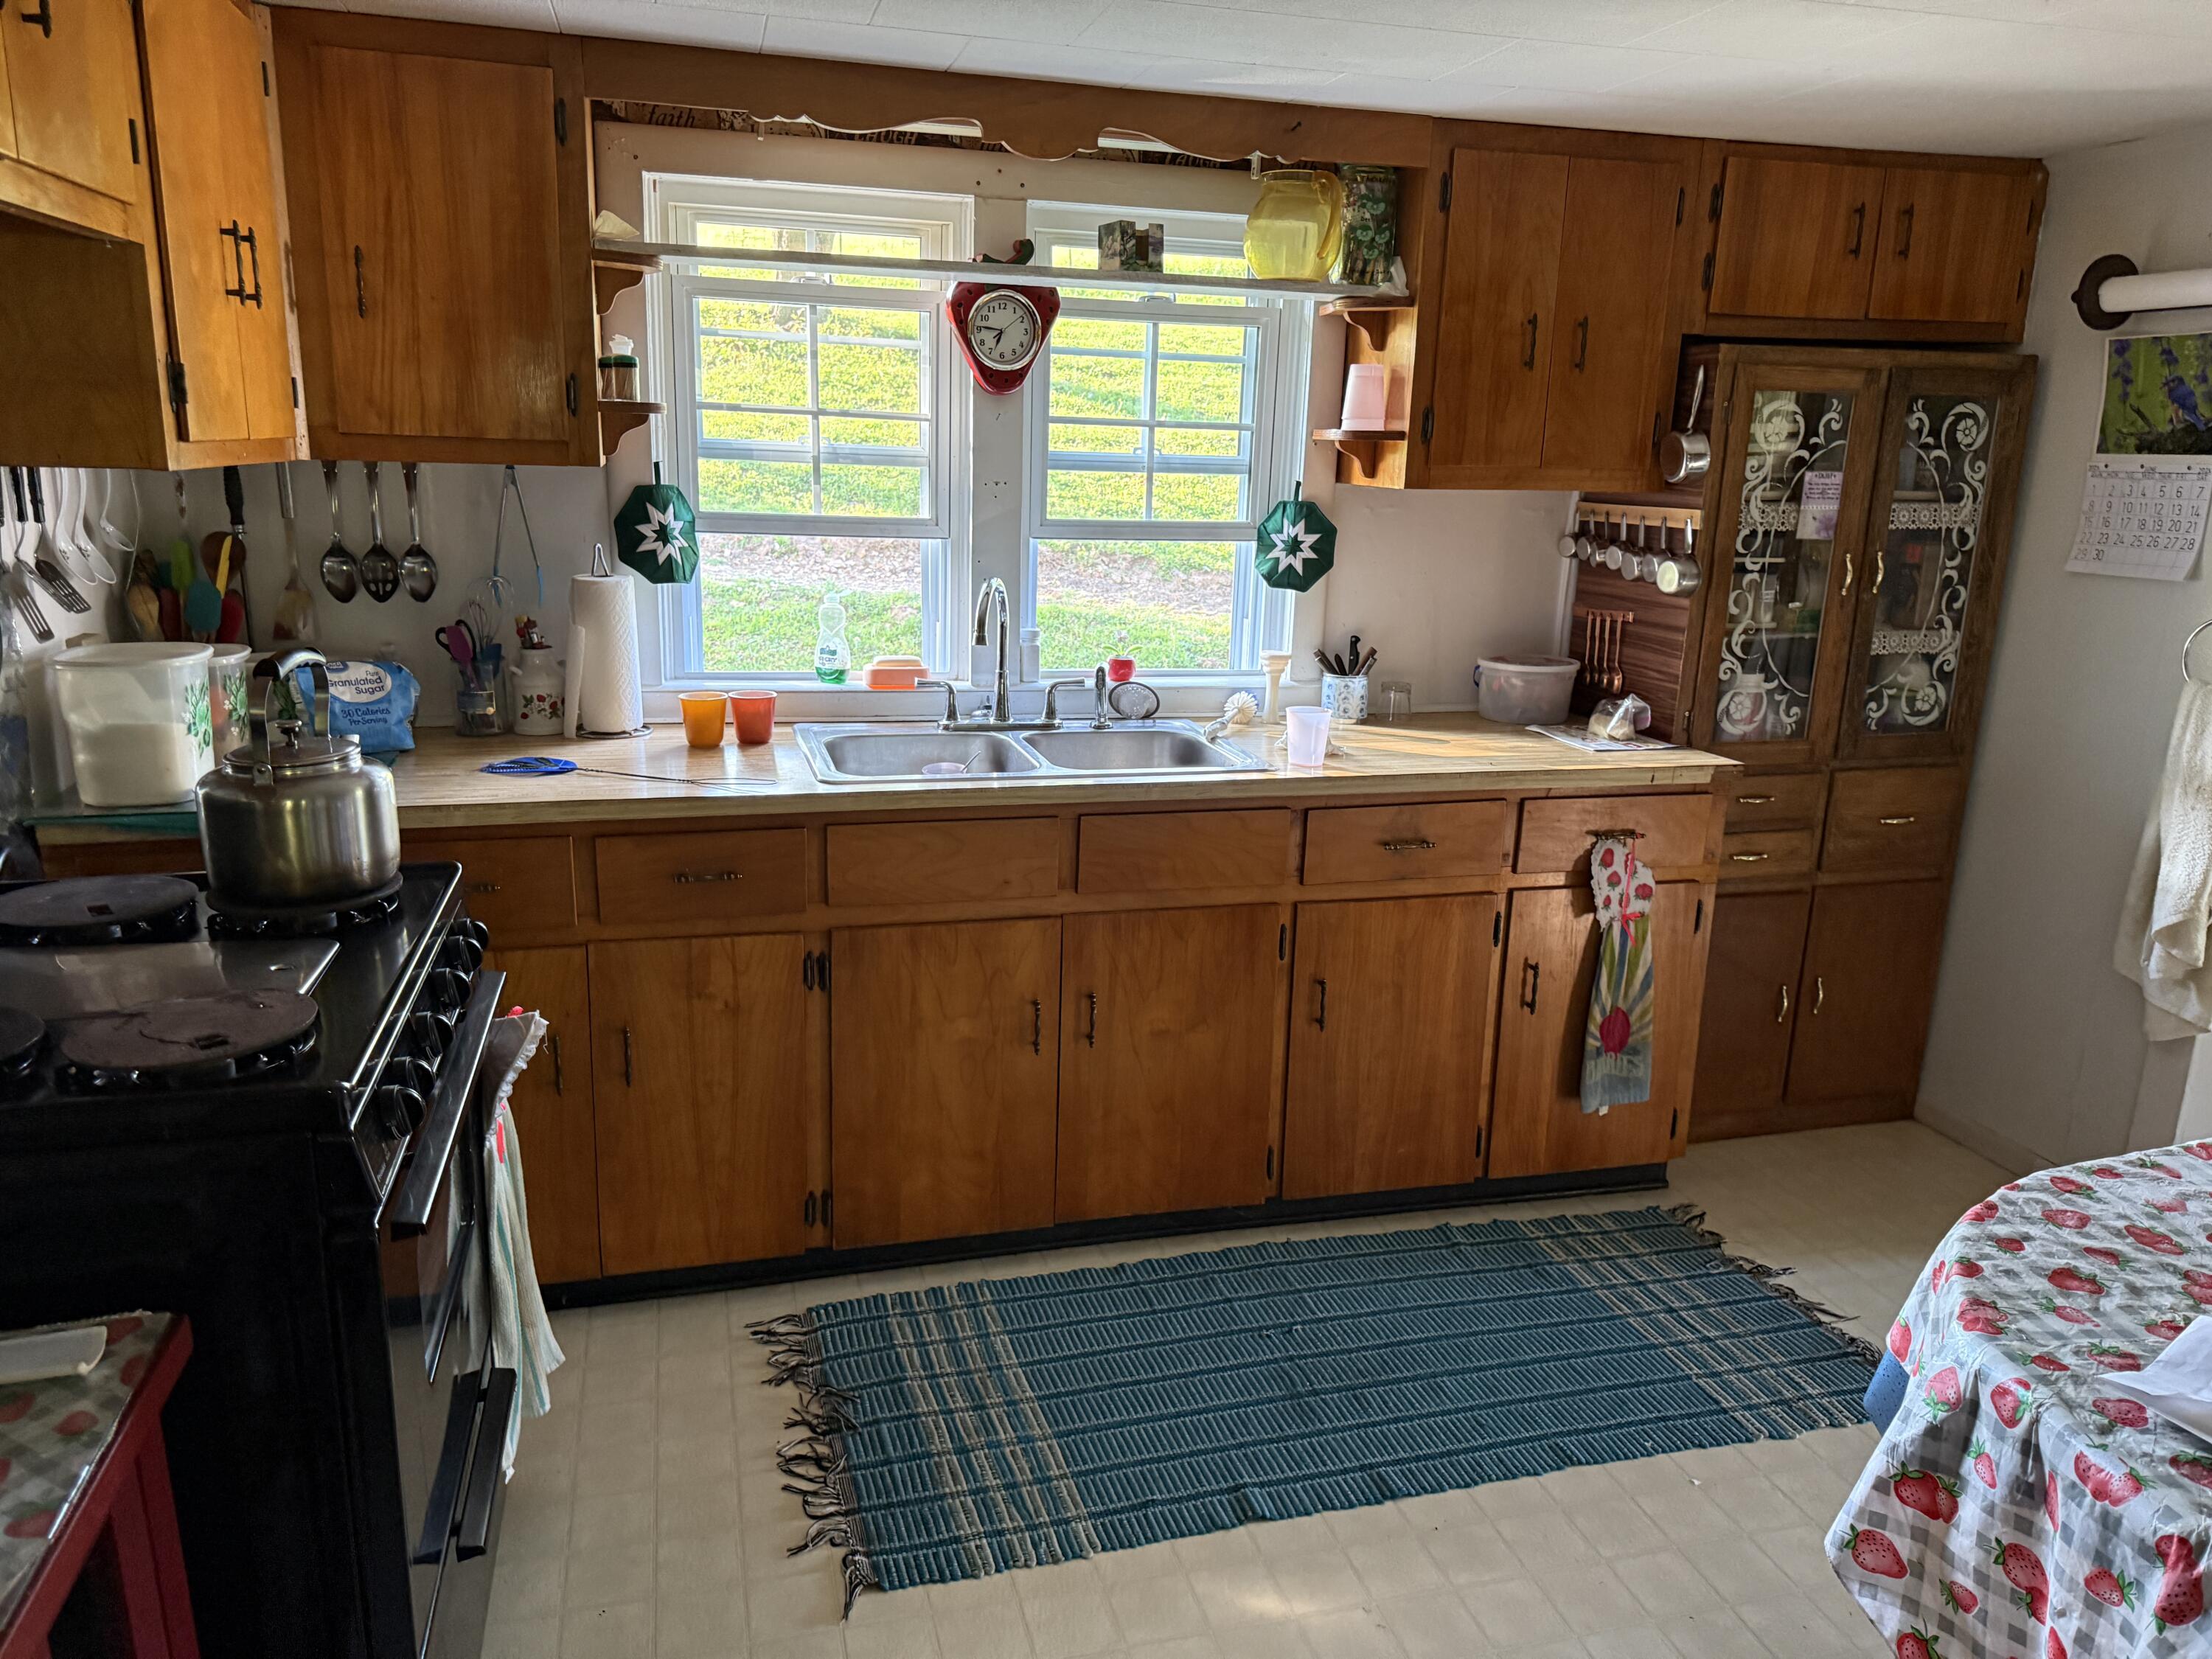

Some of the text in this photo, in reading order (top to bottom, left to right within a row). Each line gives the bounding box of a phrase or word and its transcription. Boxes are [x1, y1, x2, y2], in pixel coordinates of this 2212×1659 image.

[648, 105, 696, 128] faith
[2127, 485, 2133, 495] 3
[2160, 486, 2166, 498] 5
[2177, 487, 2183, 498] 6
[2197, 487, 2205, 498] 7
[2106, 501, 2112, 512] 9
[2124, 502, 2132, 512] 10
[2140, 503, 2147, 513] 11
[2154, 504, 2163, 515] 12
[2172, 504, 2182, 516] 13
[2191, 506, 2200, 517] 14
[2102, 518, 2110, 527] 16
[2121, 518, 2132, 528] 17
[2138, 519, 2146, 529] 18
[2153, 520, 2163, 531] 19
[2168, 521, 2181, 532] 20
[2185, 521, 2197, 533] 21
[2080, 532, 2194, 549] 22 23 24 25 26 27 28
[2075, 549, 2104, 560] 29 30
[329, 677, 383, 687] Granulated
[355, 685, 385, 695] Sugar
[341, 707, 391, 718] 30 Calories
[361, 716, 388, 725] Serving
